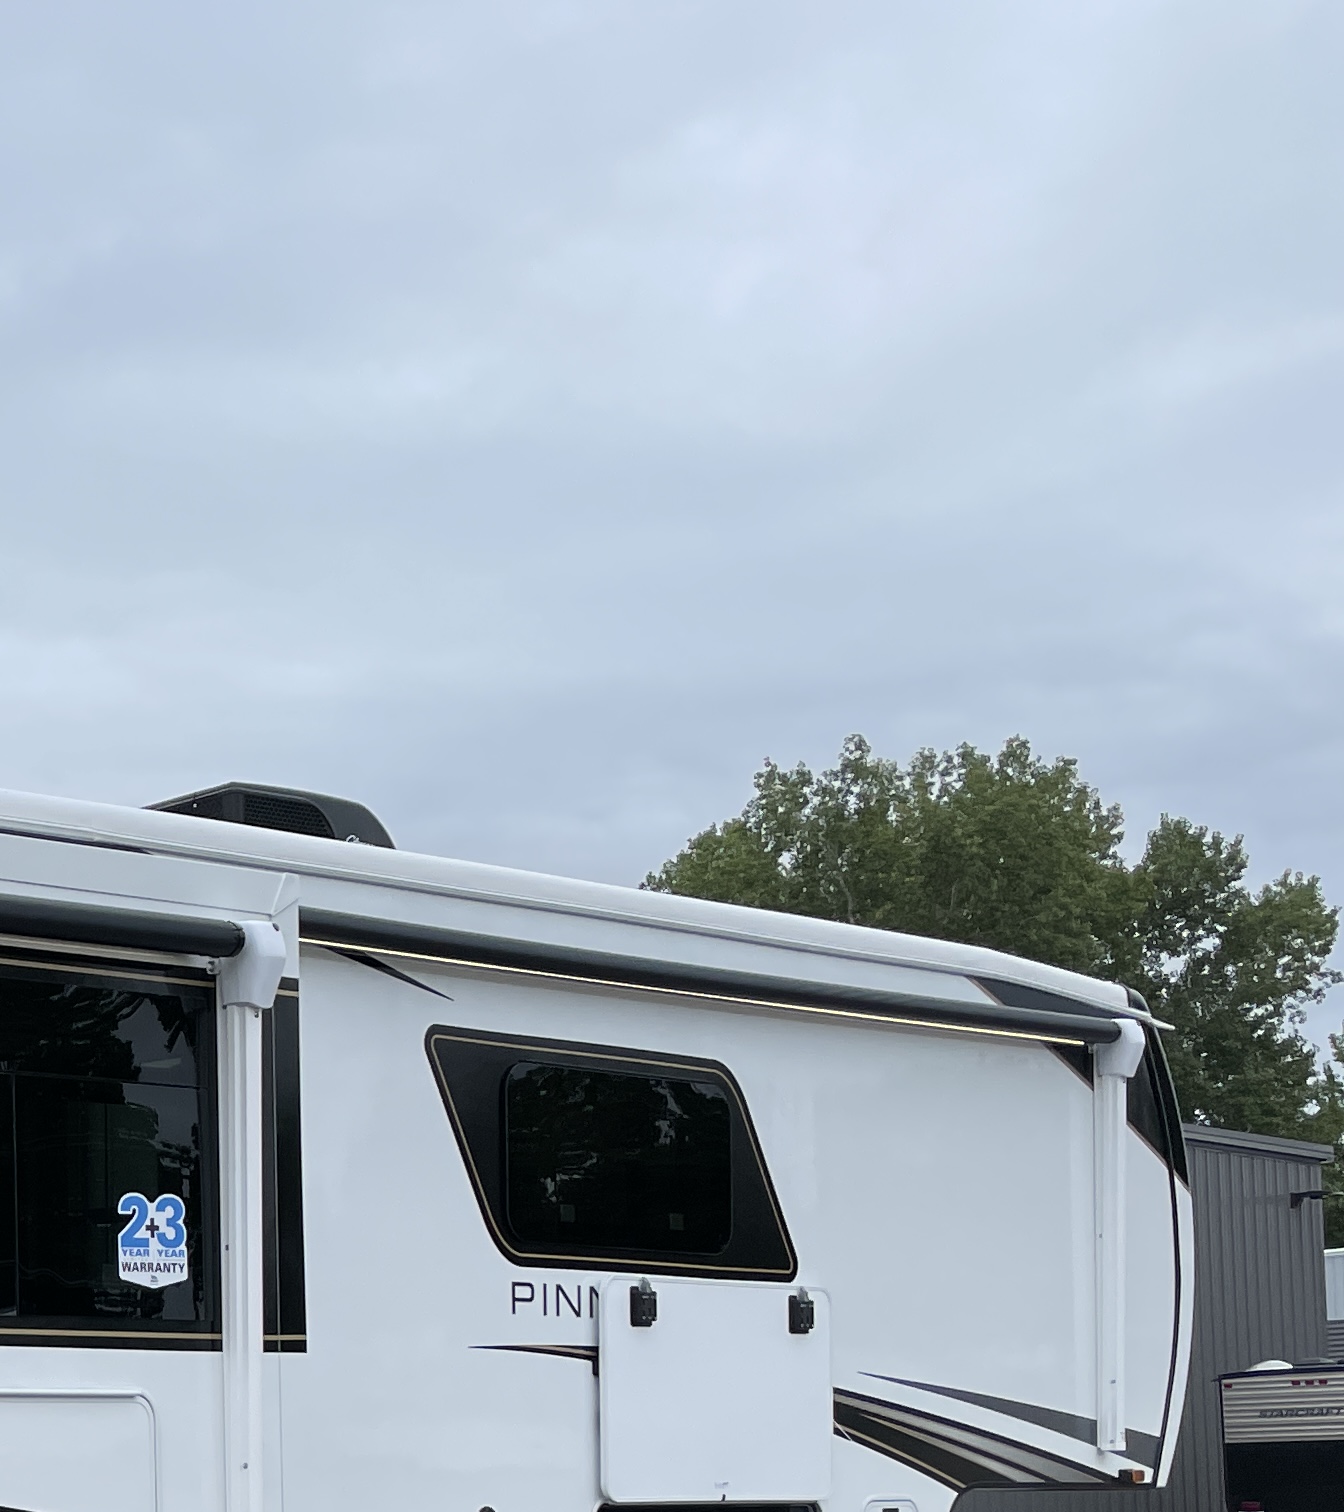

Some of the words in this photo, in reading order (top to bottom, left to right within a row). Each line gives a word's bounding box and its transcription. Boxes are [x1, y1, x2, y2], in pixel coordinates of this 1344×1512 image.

[122, 1249, 150, 1257] YEAR
[157, 1249, 185, 1258] YEAR
[121, 1261, 186, 1273] WARRANTY
